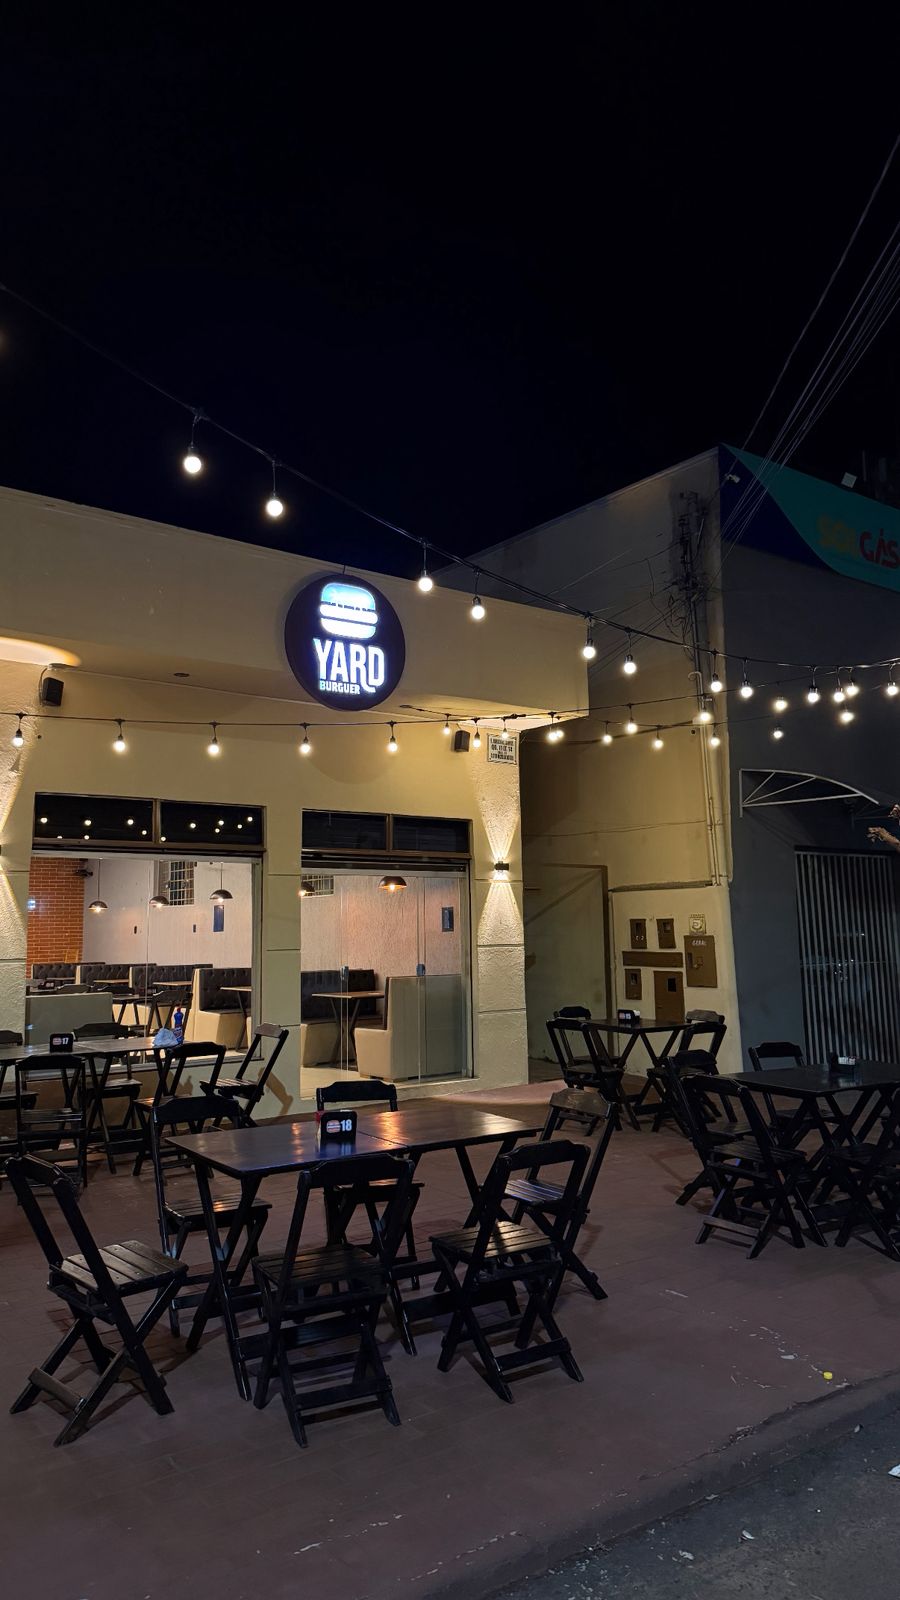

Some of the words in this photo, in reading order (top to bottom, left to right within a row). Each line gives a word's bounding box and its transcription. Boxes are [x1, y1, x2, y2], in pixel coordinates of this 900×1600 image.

[313, 638, 385, 693] YARD
[319, 681, 361, 695] BURGUER
[62, 1037, 69, 1045] 17
[340, 1119, 352, 1132] 18
